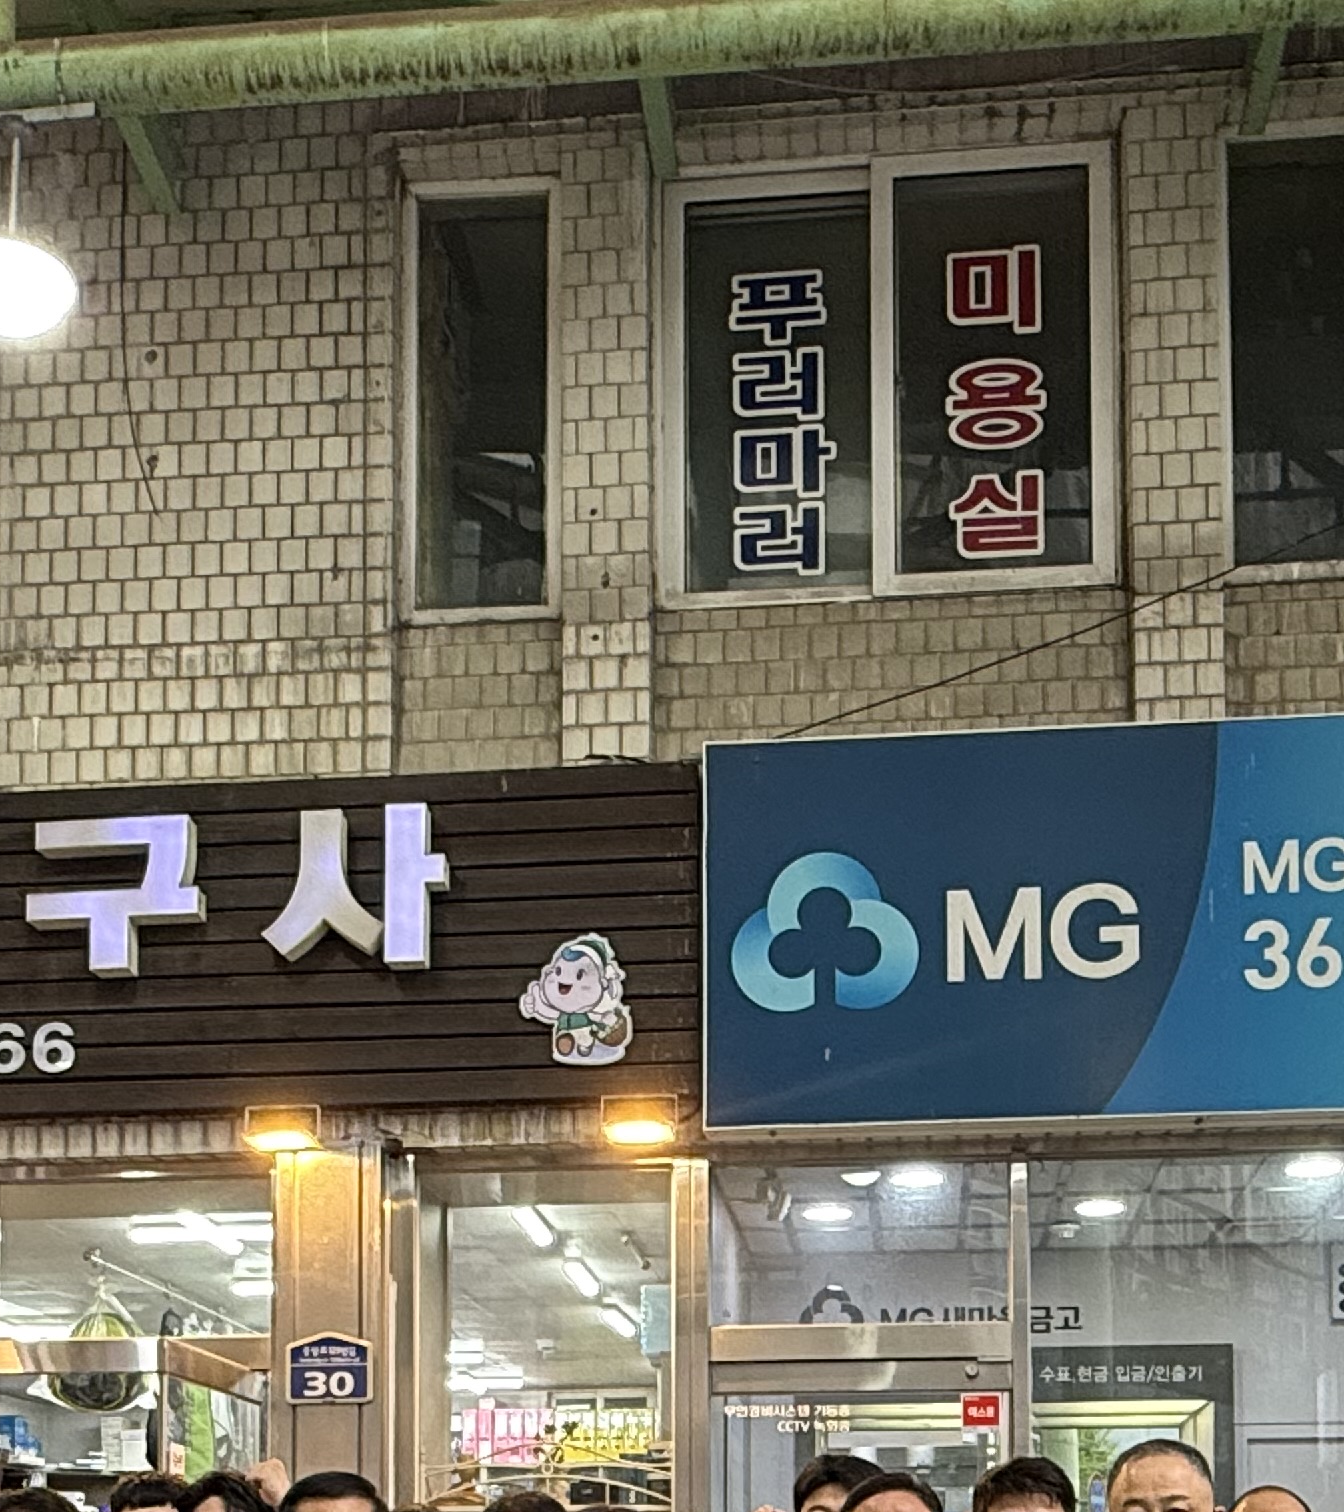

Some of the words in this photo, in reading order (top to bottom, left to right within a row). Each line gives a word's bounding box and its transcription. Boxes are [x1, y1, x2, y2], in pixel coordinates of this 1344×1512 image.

[946, 244, 1047, 559] 미용실
[944, 883, 1142, 984] MG
[302, 1370, 355, 1397] 30
[776, 1420, 810, 1433] CCTV
